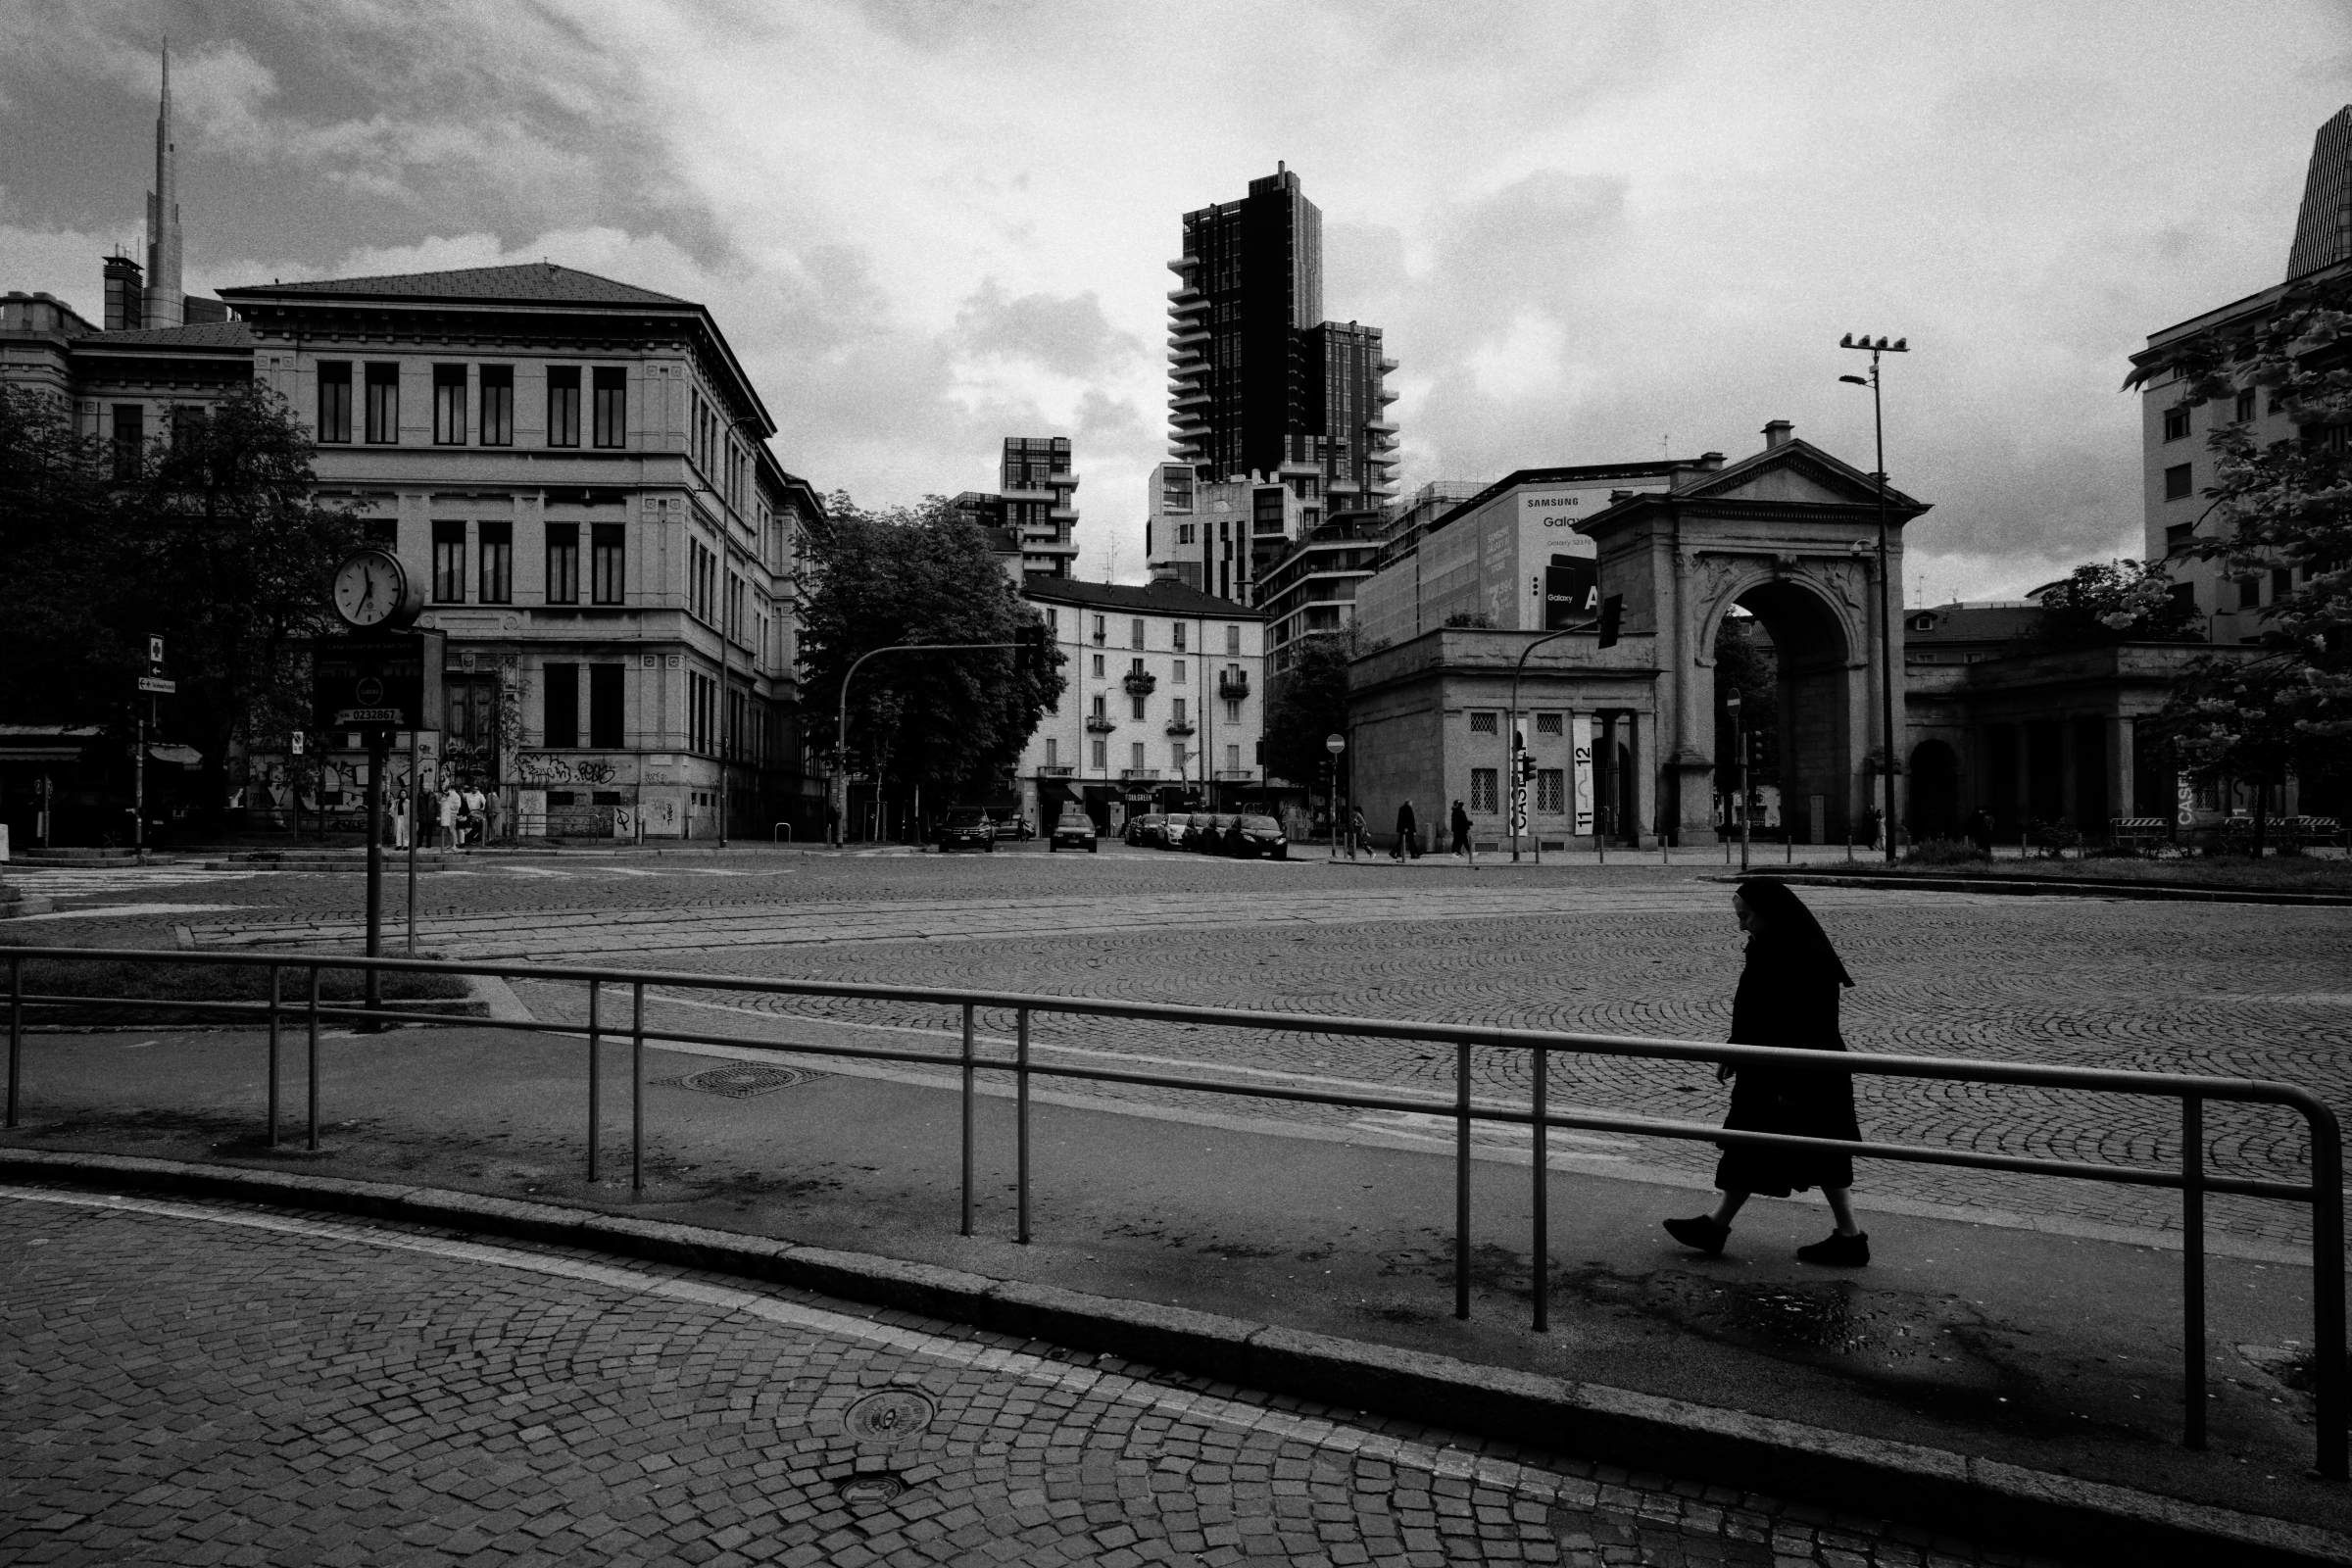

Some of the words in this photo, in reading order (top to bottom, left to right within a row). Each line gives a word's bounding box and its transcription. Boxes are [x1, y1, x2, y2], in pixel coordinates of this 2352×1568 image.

[1528, 498, 1579, 508] SAMSUNG
[1544, 515, 1586, 527] Gala
[1547, 593, 1573, 604] Galaxy
[1575, 747, 1591, 766] 12
[1578, 811, 1592, 827] 11
